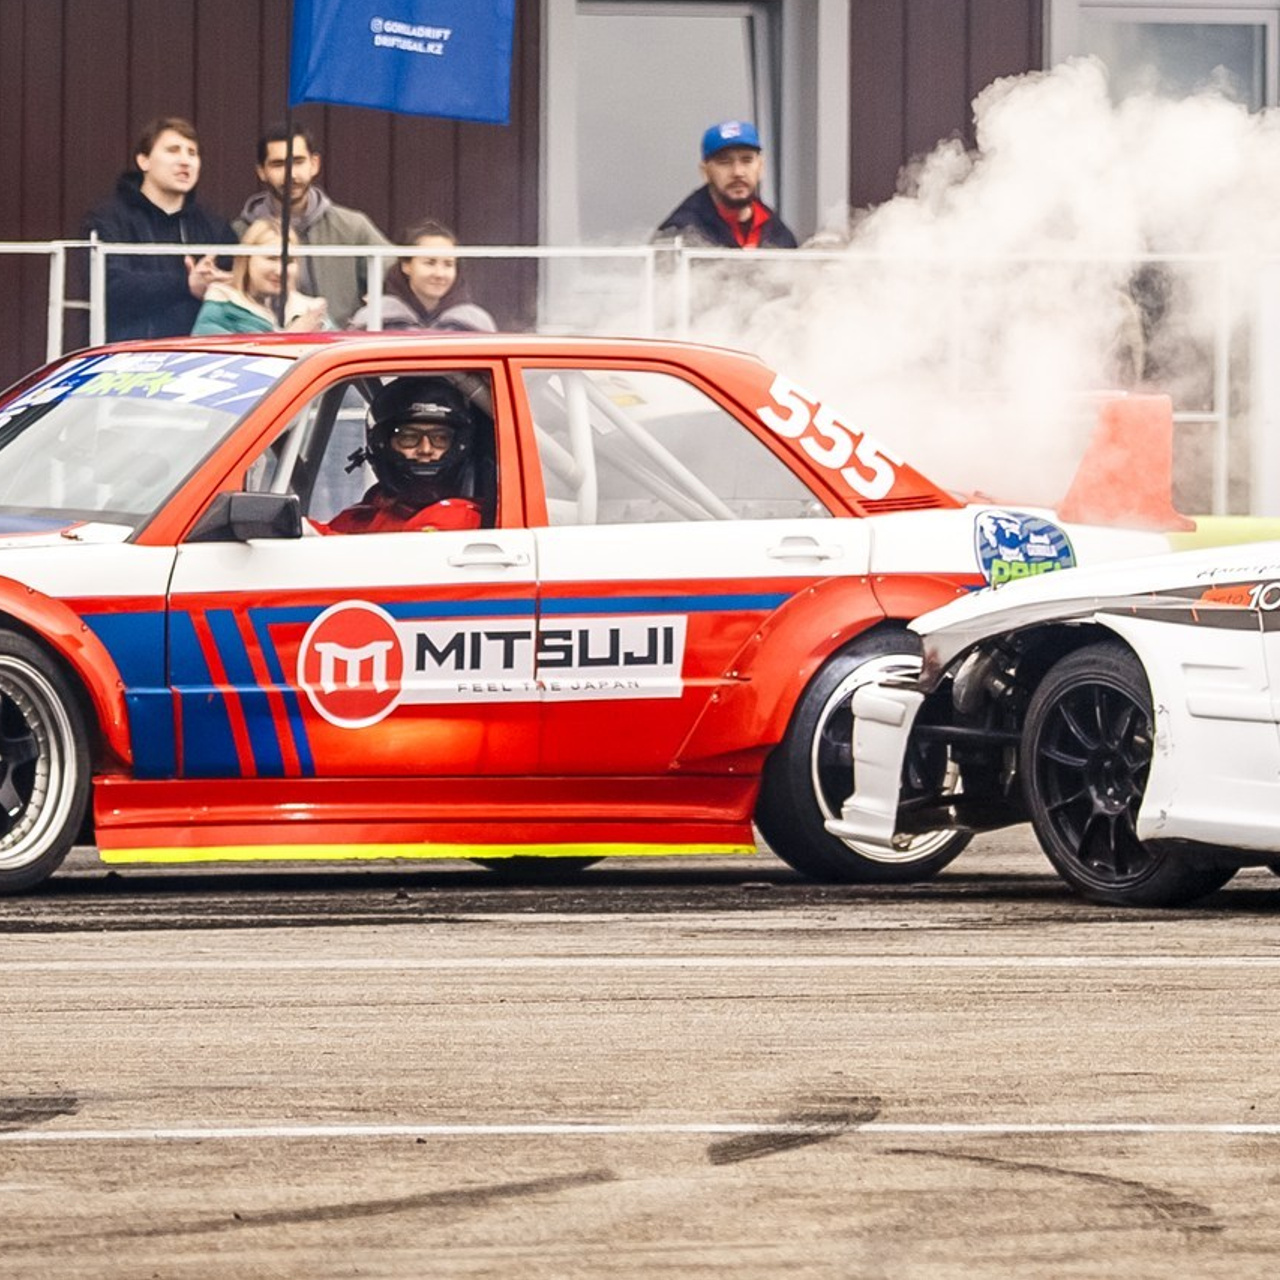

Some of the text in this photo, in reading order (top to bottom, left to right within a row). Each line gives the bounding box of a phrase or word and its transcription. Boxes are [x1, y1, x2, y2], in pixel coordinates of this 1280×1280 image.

[755, 373, 906, 500] 555
[415, 626, 674, 671] MITSUJI
[457, 682, 513, 693] FEEL
[571, 680, 640, 691] JAPAN
